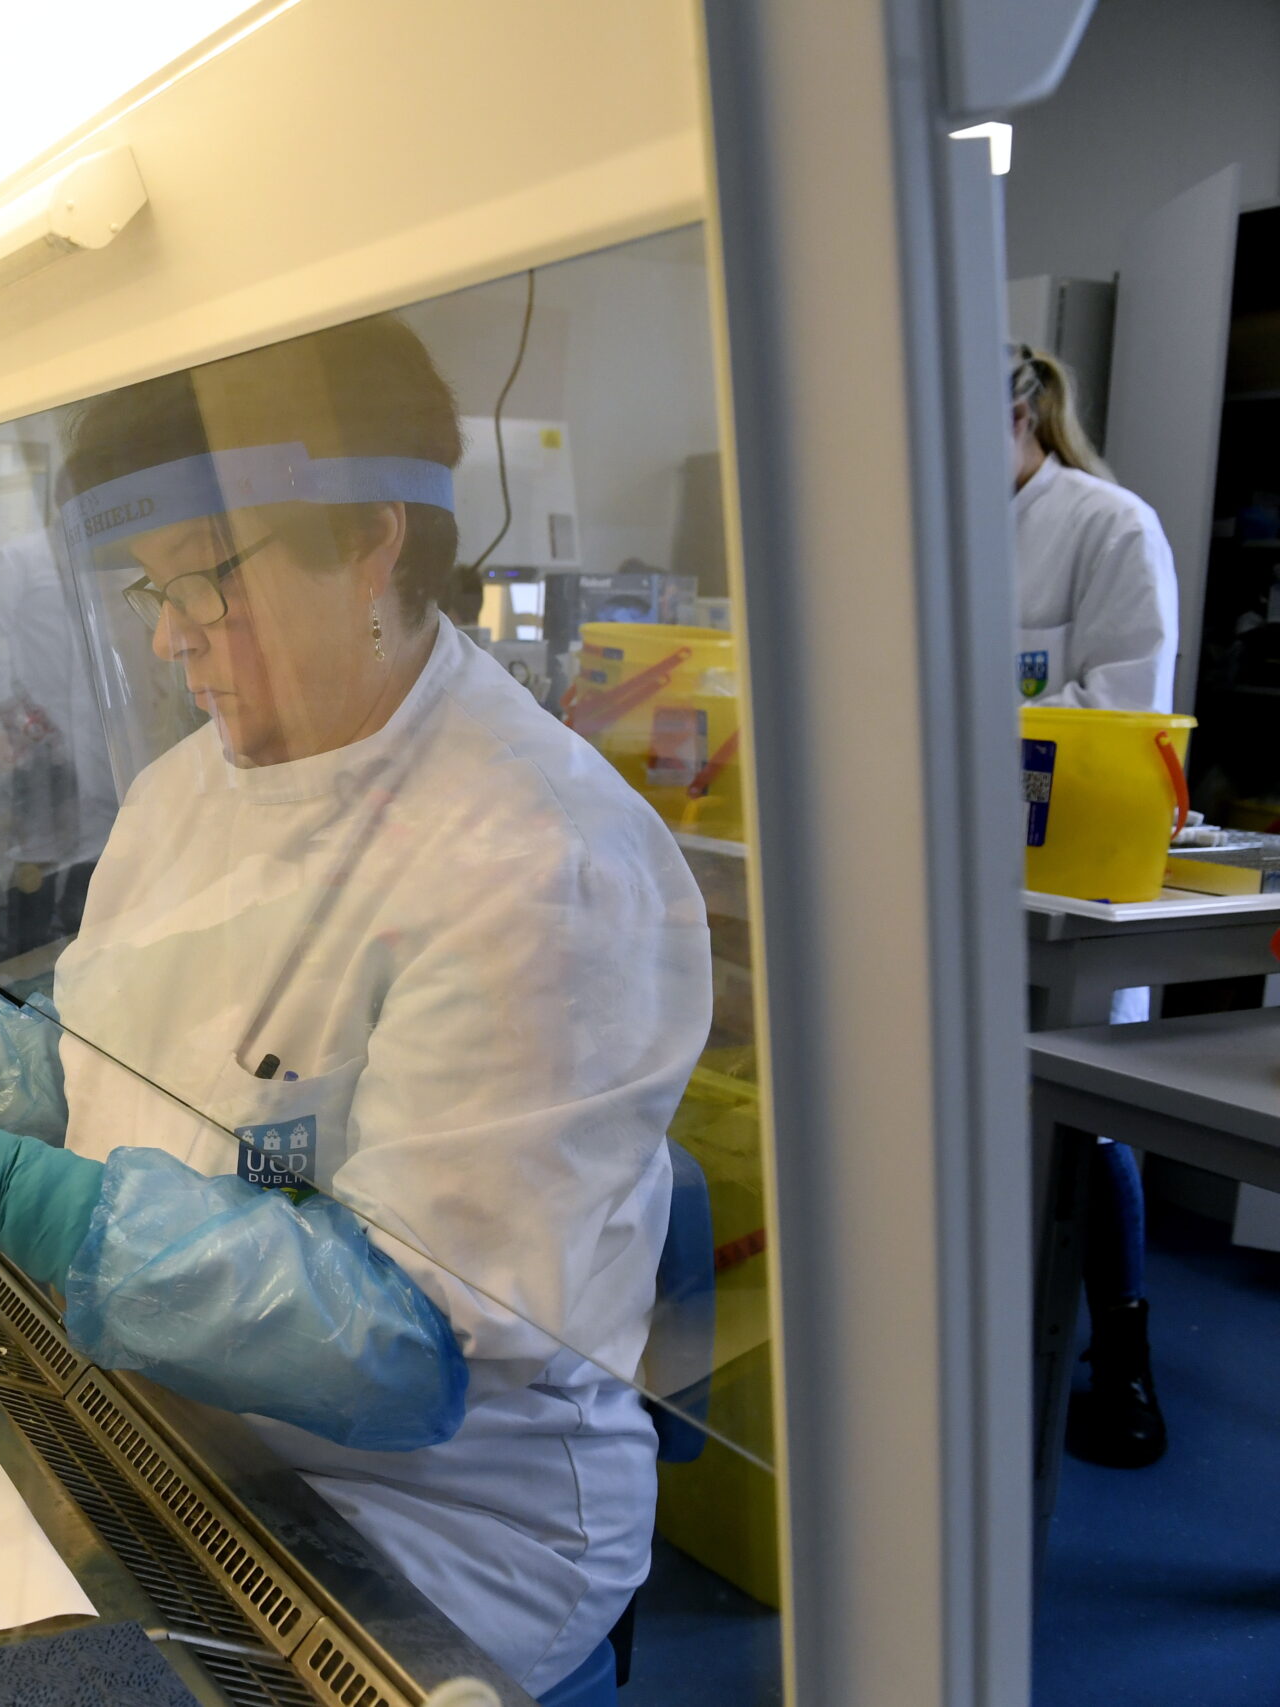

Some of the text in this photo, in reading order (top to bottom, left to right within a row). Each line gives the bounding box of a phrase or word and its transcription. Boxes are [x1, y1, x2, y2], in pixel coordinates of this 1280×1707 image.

[84, 497, 155, 537] SHIELD
[246, 1149, 308, 1173] UCD
[248, 1173, 303, 1184] DUBLI
